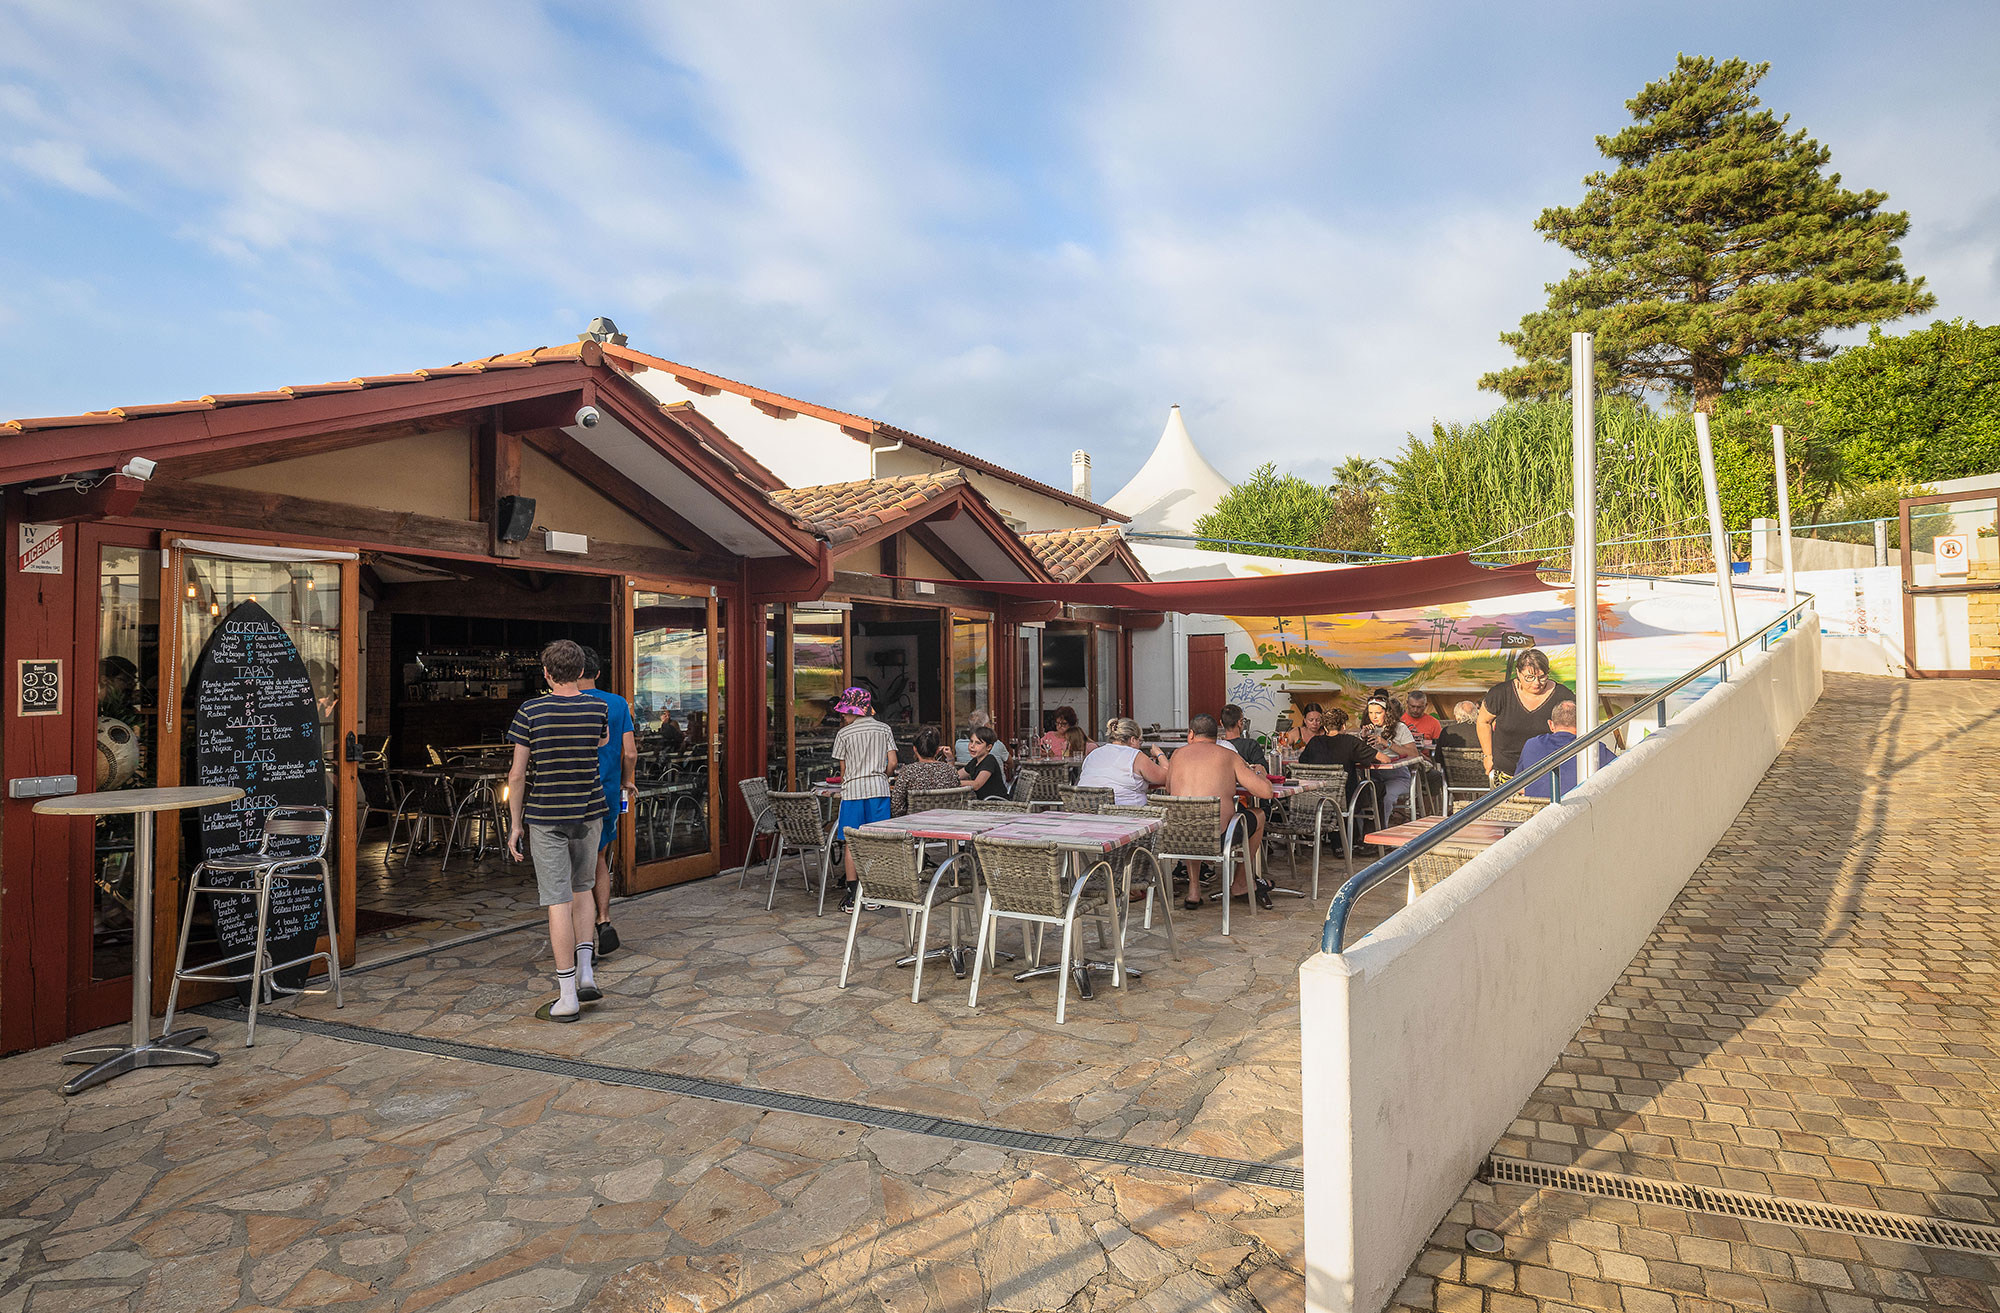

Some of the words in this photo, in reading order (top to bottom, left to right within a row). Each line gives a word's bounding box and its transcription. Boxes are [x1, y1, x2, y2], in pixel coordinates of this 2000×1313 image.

[24, 527, 38, 537] IV
[23, 531, 60, 566] LICENCE
[232, 664, 274, 678] TAPAS
[202, 680, 221, 688] Planche
[200, 696, 222, 704] Planche
[226, 714, 278, 728] SALADES
[200, 730, 208, 738] La
[272, 726, 294, 734] Basque
[200, 738, 210, 746] La
[201, 746, 211, 754] La
[234, 748, 277, 762] PLATS
[201, 765, 224, 776] Poulet
[262, 763, 277, 772] Plato
[278, 760, 304, 770] combinado
[230, 794, 279, 811] BURGERS
[204, 814, 212, 822] Le
[212, 812, 238, 822] Classique
[202, 824, 210, 832] Le
[270, 888, 292, 900] Salade
[292, 888, 300, 896] de
[213, 898, 238, 910] Planche
[241, 894, 251, 904] de
[292, 902, 312, 913] basque
[244, 912, 254, 920] au
[282, 916, 300, 926] boule
[278, 926, 283, 936] 3
[284, 924, 302, 934] boules
